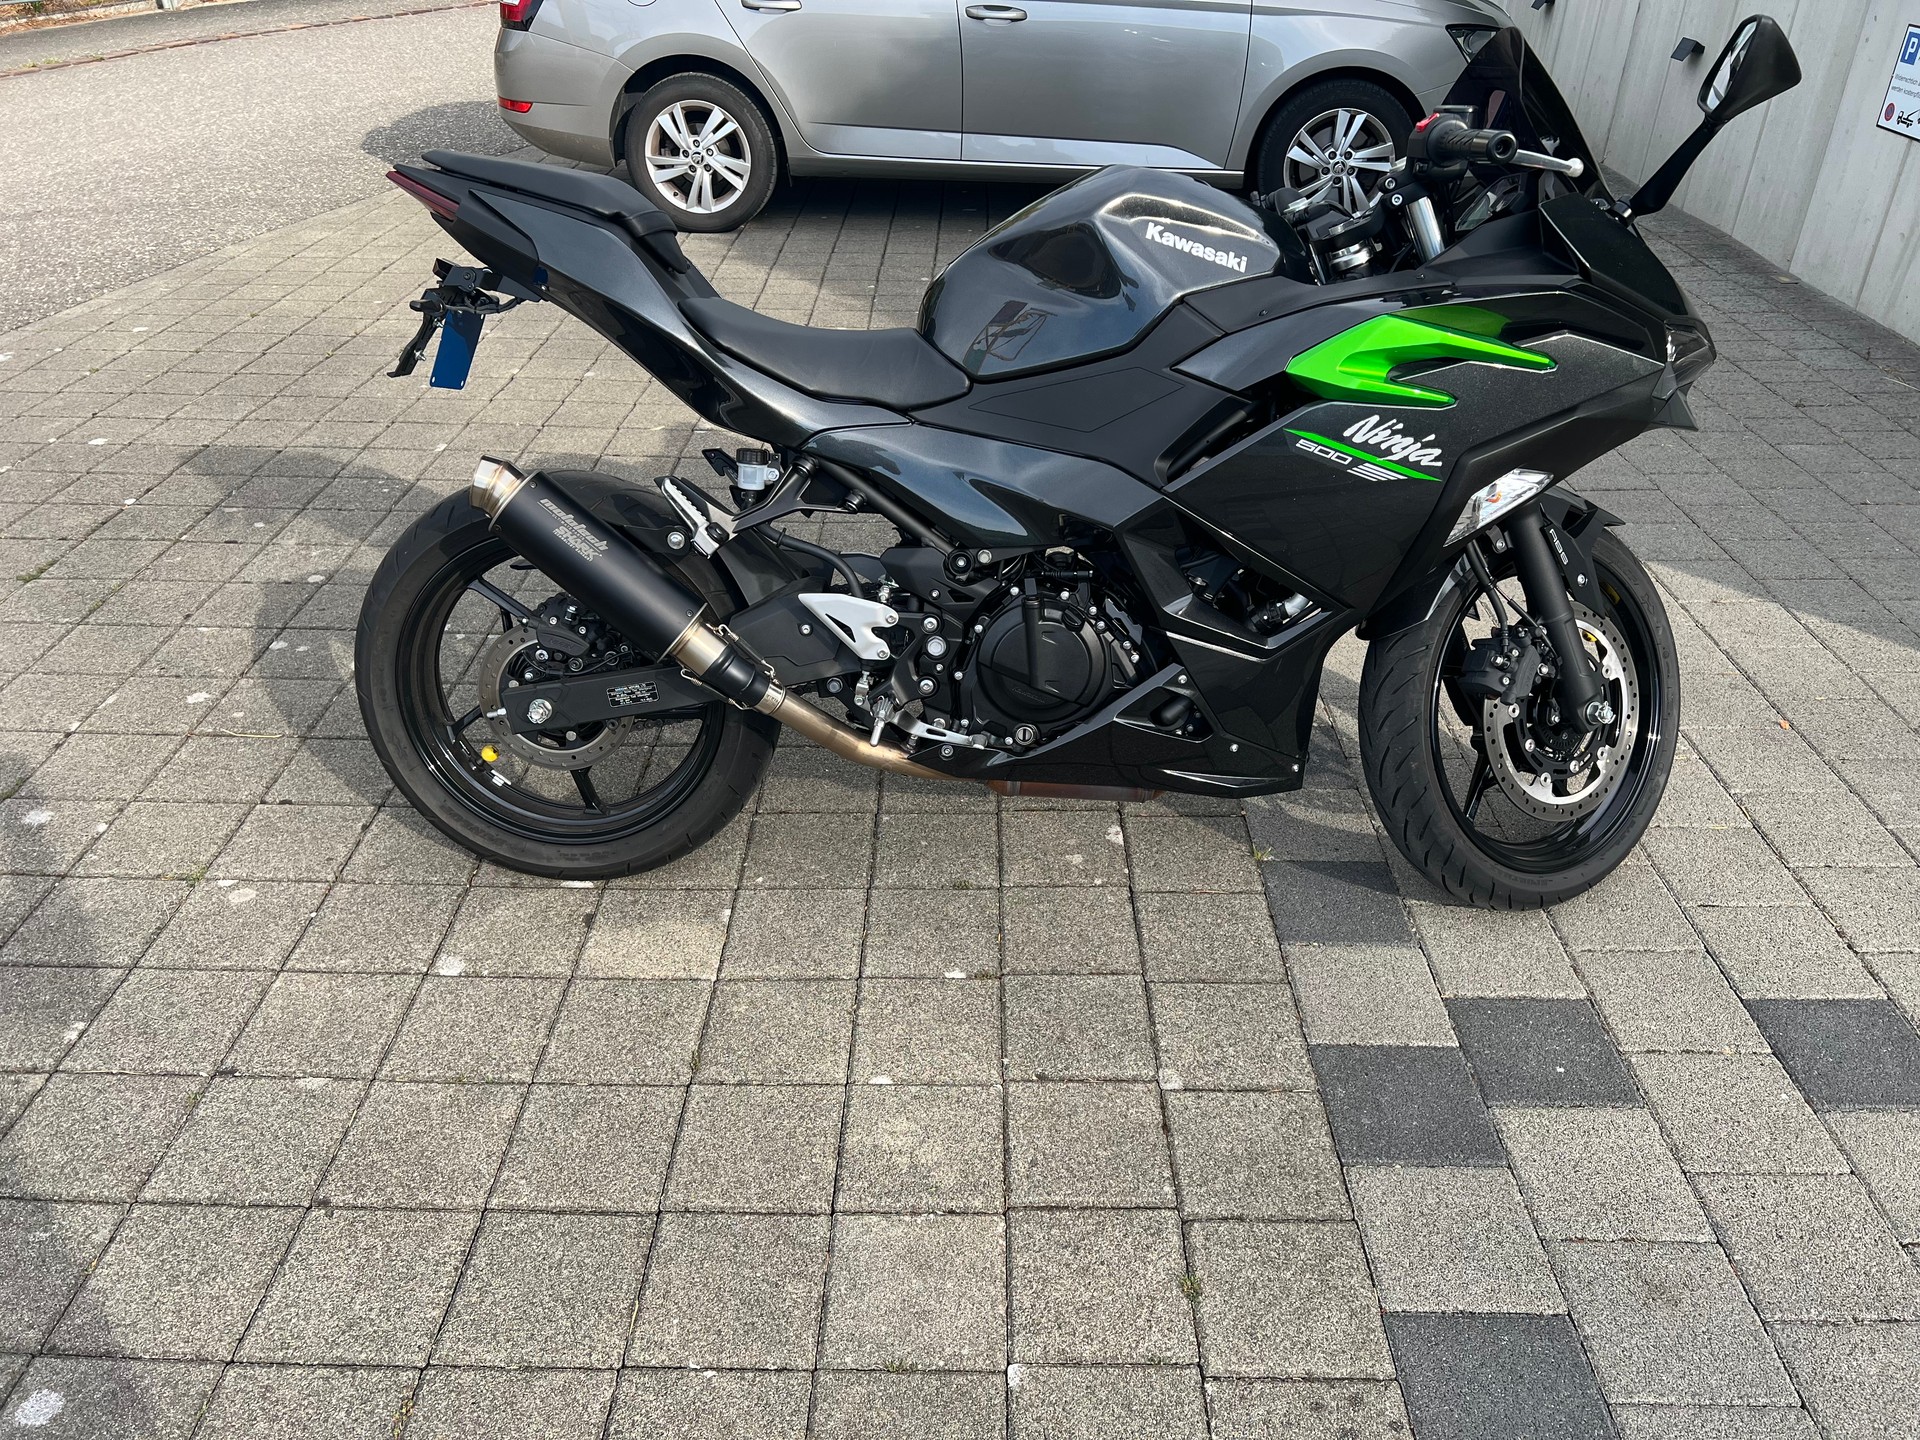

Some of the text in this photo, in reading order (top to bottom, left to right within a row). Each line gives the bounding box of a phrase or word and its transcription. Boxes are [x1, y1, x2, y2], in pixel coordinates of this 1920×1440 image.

[1905, 37, 1918, 60] P
[1145, 222, 1247, 273] Kawasaki
[1296, 439, 1352, 465] 500
[1343, 415, 1442, 466] Ninja
[557, 525, 599, 558] SHARK
[1550, 528, 1569, 565] ABS
